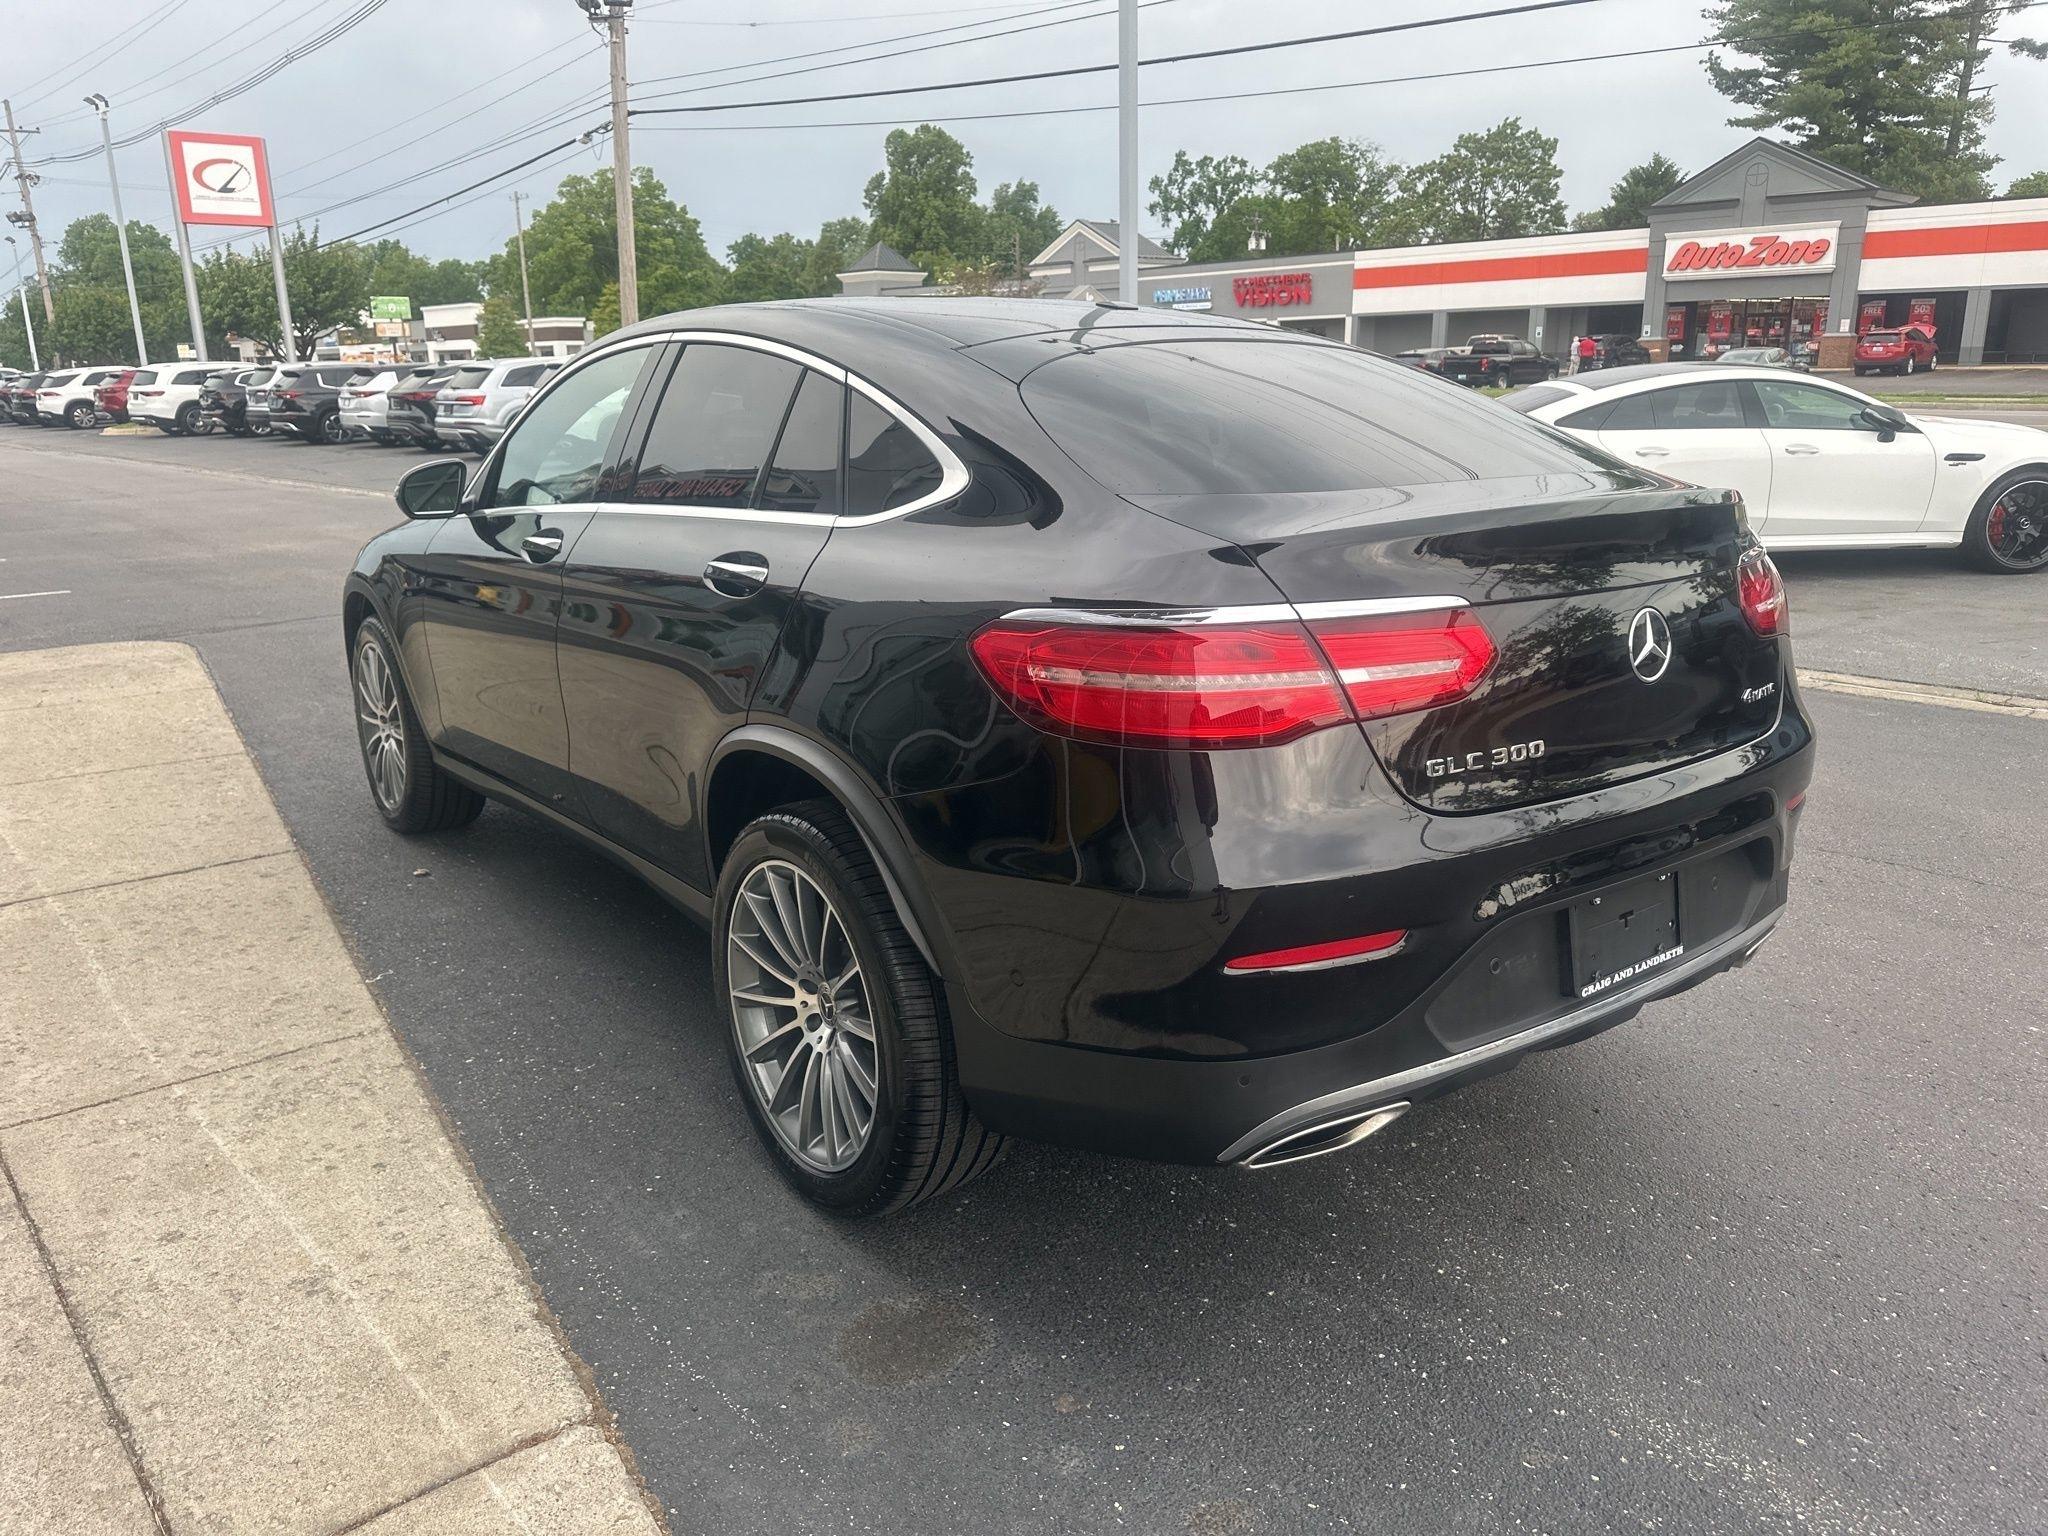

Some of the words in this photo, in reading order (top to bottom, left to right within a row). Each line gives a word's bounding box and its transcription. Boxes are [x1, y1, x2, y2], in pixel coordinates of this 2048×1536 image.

[1667, 235, 1831, 271] AutoZone
[1233, 286, 1313, 308] VISION
[1863, 306, 1883, 315] FREE
[1426, 752, 1484, 777] GLC
[1491, 740, 1545, 766] 300
[1581, 977, 1611, 998] CRAIG
[1613, 967, 1633, 984] AND
[1635, 946, 1684, 974] LANDRETH
